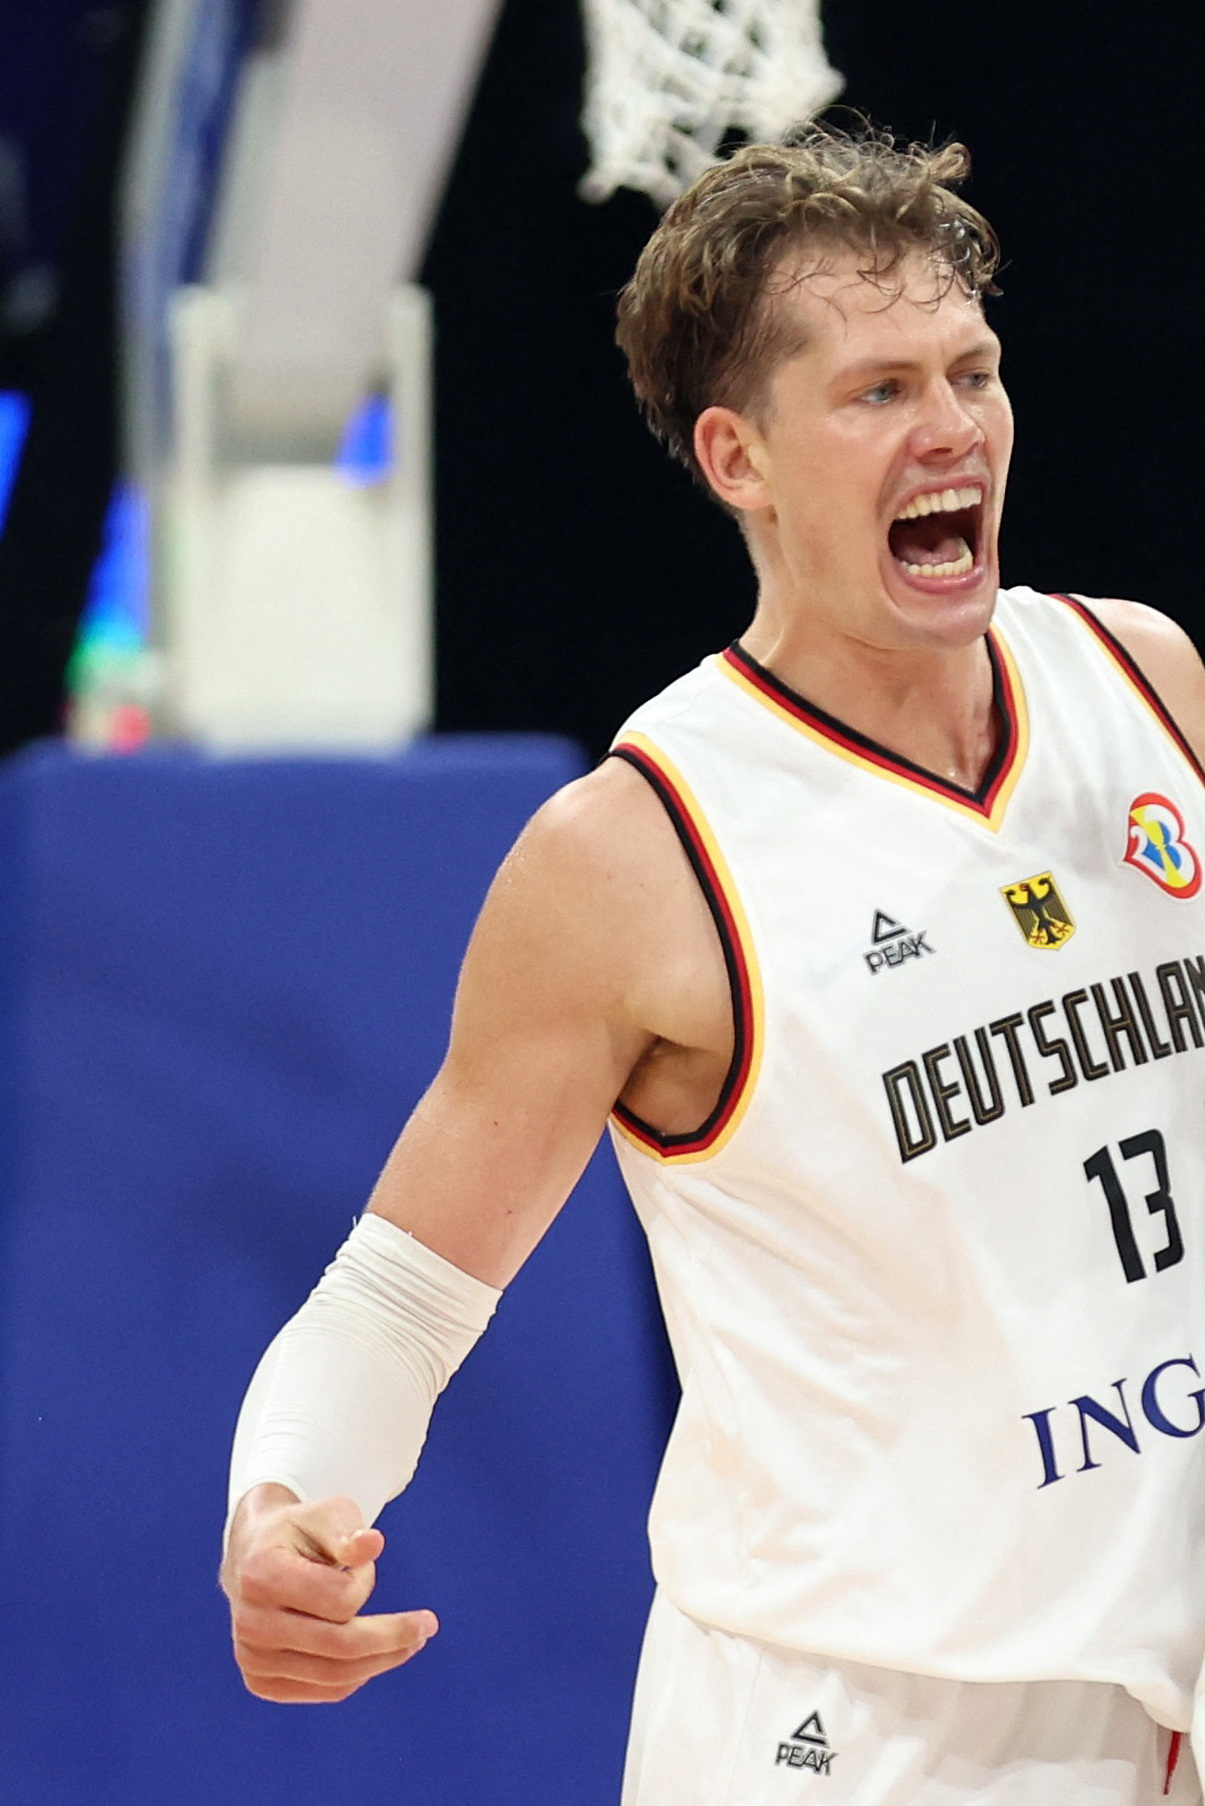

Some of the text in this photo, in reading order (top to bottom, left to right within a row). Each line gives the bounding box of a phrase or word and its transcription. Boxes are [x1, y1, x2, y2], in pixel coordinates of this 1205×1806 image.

[863, 930, 936, 975] PEAK
[1083, 1129, 1185, 1283] 13
[775, 1741, 839, 1776] PEAK
